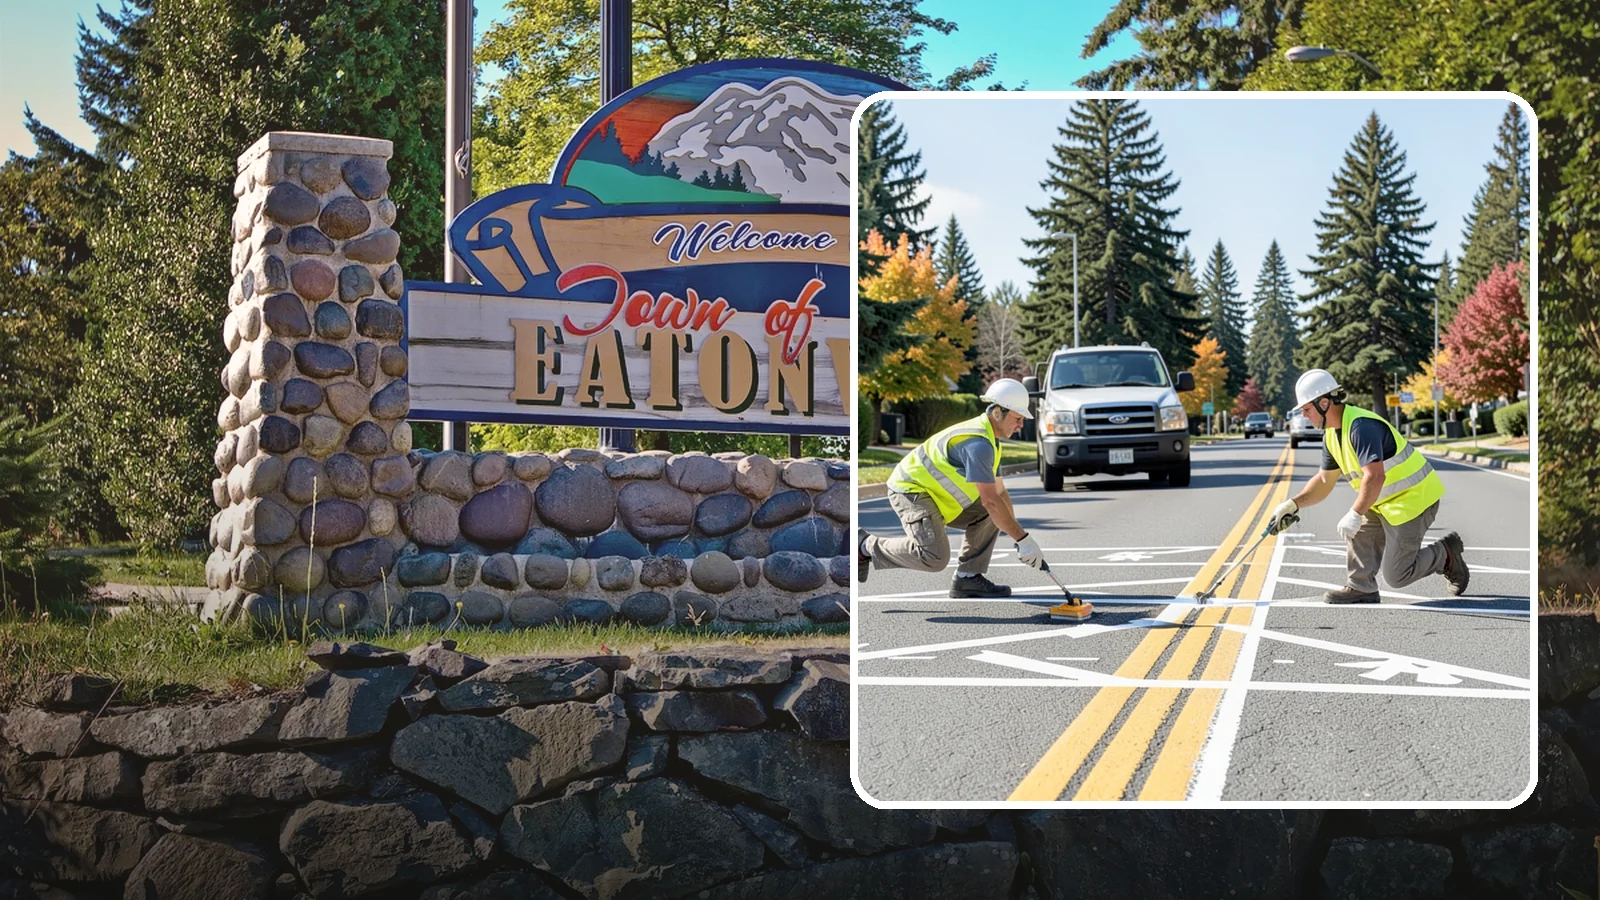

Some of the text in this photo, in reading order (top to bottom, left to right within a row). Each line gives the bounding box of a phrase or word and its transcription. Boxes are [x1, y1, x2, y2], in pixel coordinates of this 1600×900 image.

[653, 220, 837, 263] Welcome
[556, 263, 826, 365] Town of
